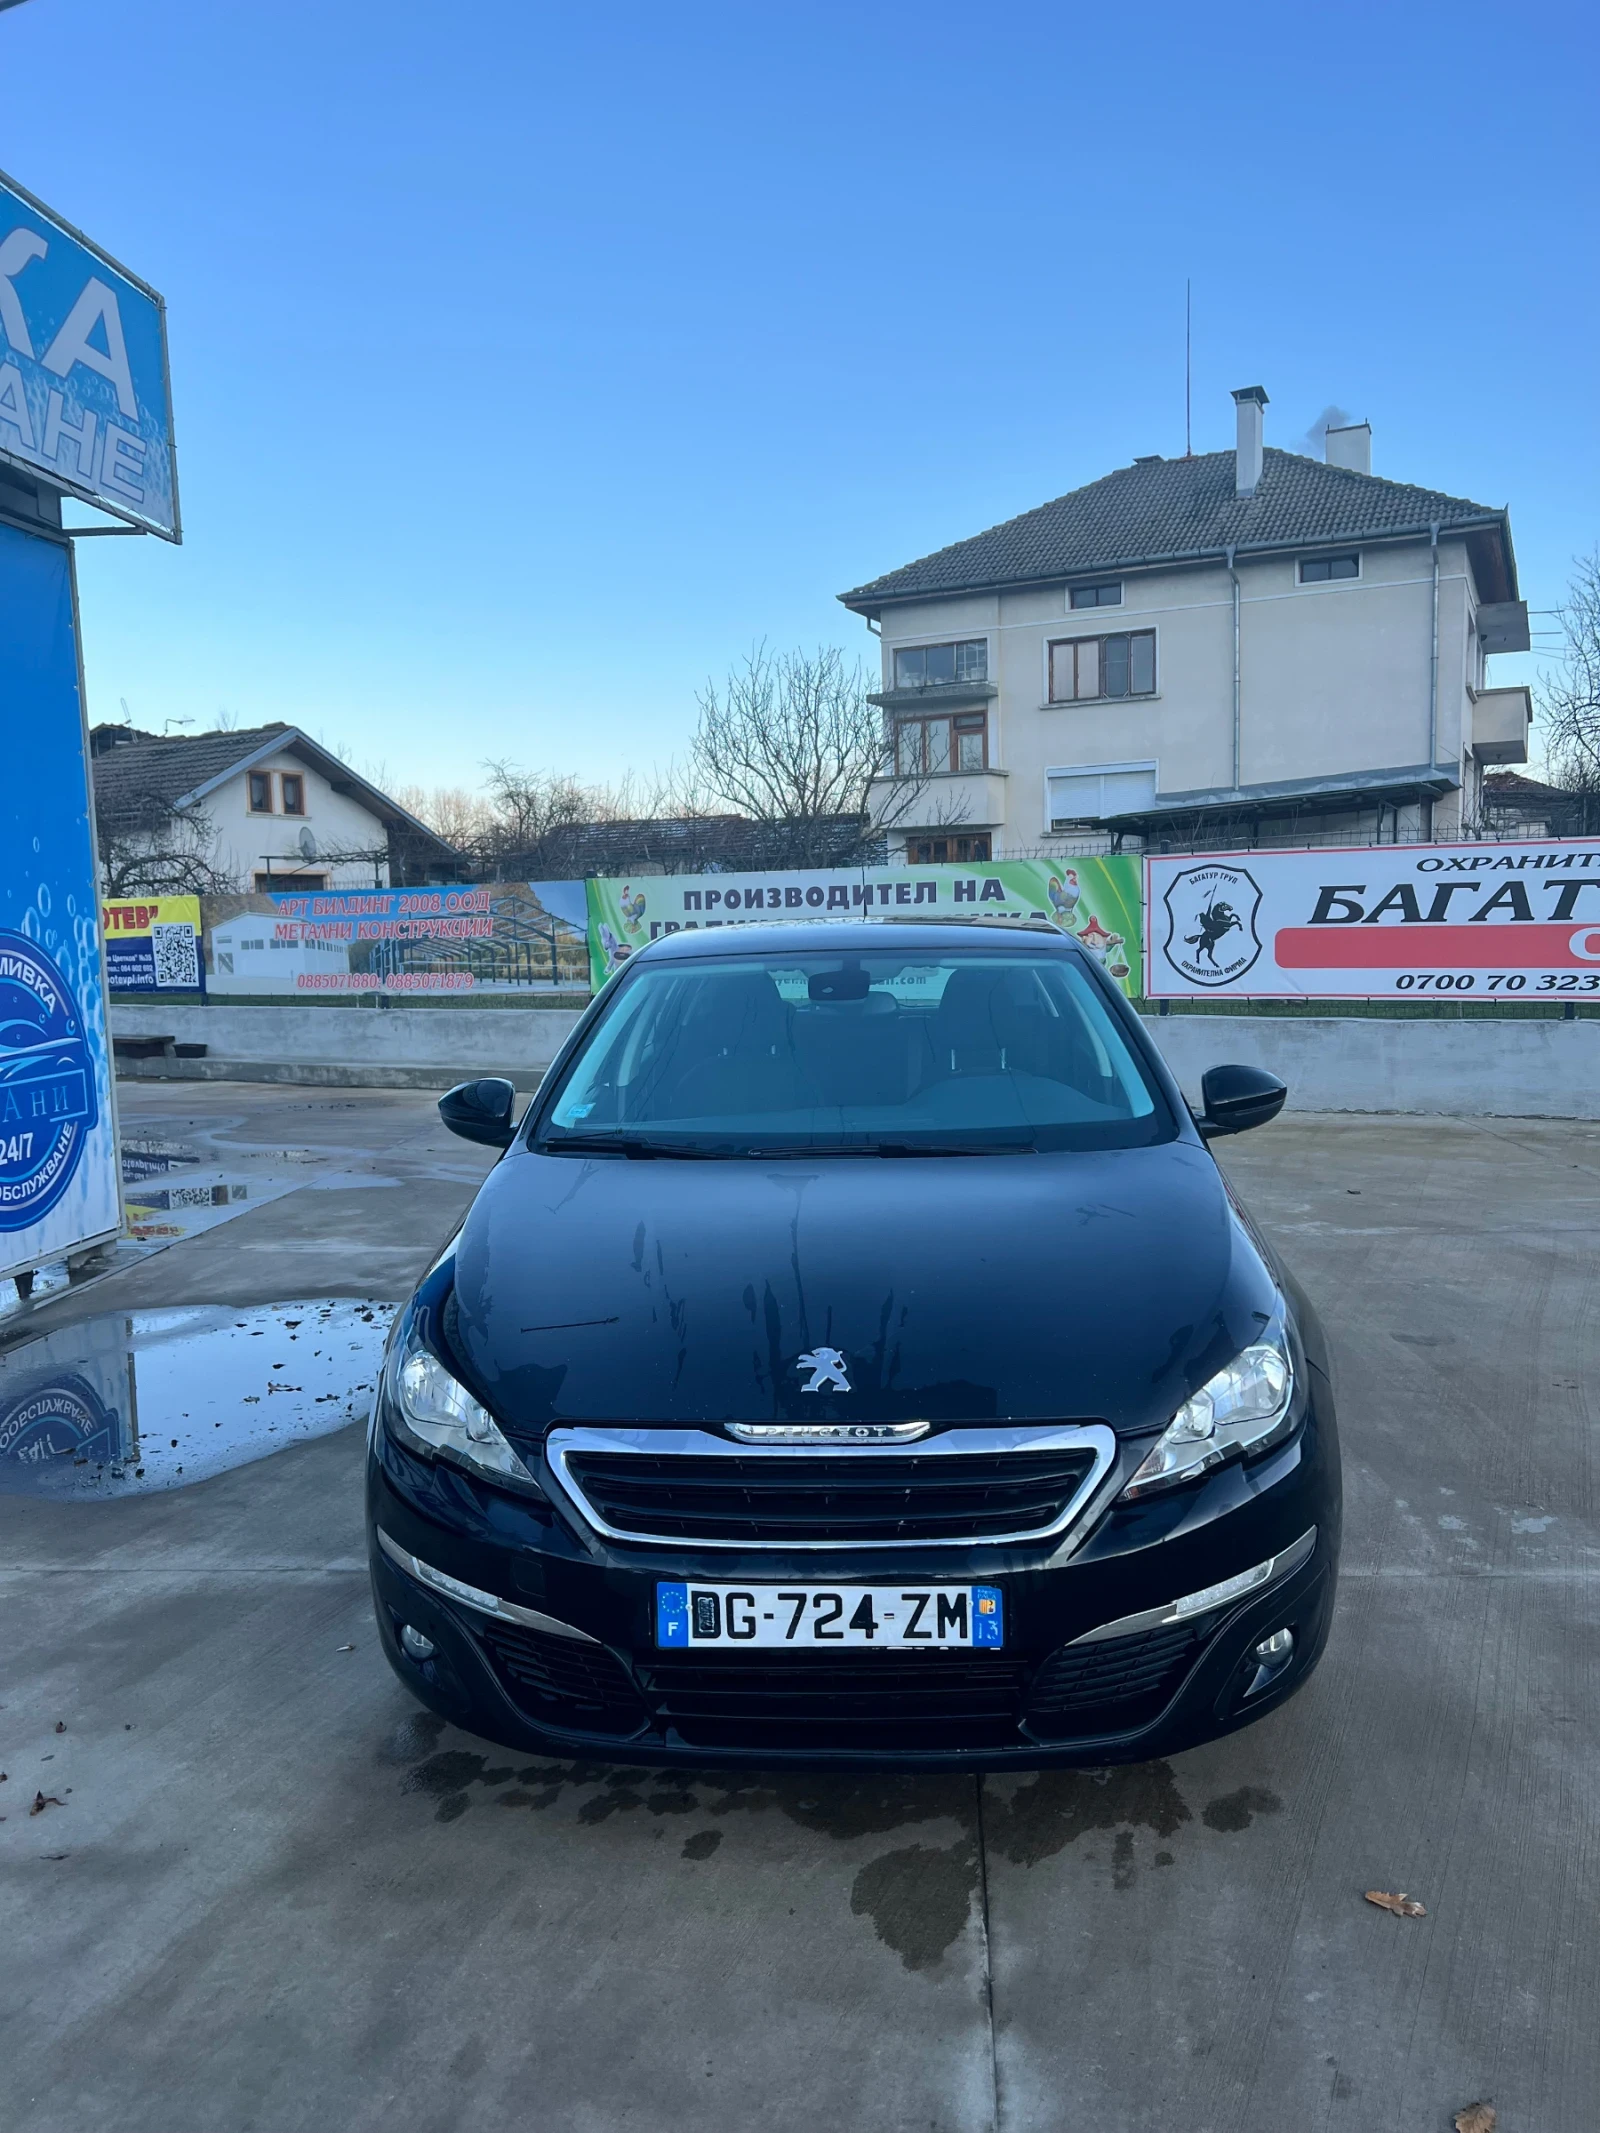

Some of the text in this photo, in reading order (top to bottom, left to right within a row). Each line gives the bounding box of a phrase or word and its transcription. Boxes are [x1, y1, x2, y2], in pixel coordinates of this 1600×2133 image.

[1189, 872, 1238, 885] БАГАТУР ГРУП
[278, 891, 491, 917] АРТ БИЛДИНГ 2008 ООД
[684, 879, 1006, 910] ПРОИЗВОДИТЕЛ НА
[1307, 878, 1600, 924] БАГАТ
[274, 918, 493, 940] МЕТАЛНИ КОНСТРУКЦИИ
[1181, 957, 1247, 977] ОХРАНИТЕЛНА ФИРМА
[386, 972, 475, 990] 0885071879
[1396, 975, 1600, 991] 0700 70 323
[0, 1121, 73, 1201] БСЛУЖВАНЕ
[765, 1426, 888, 1438] PEUGEOT
[668, 1622, 679, 1636] F
